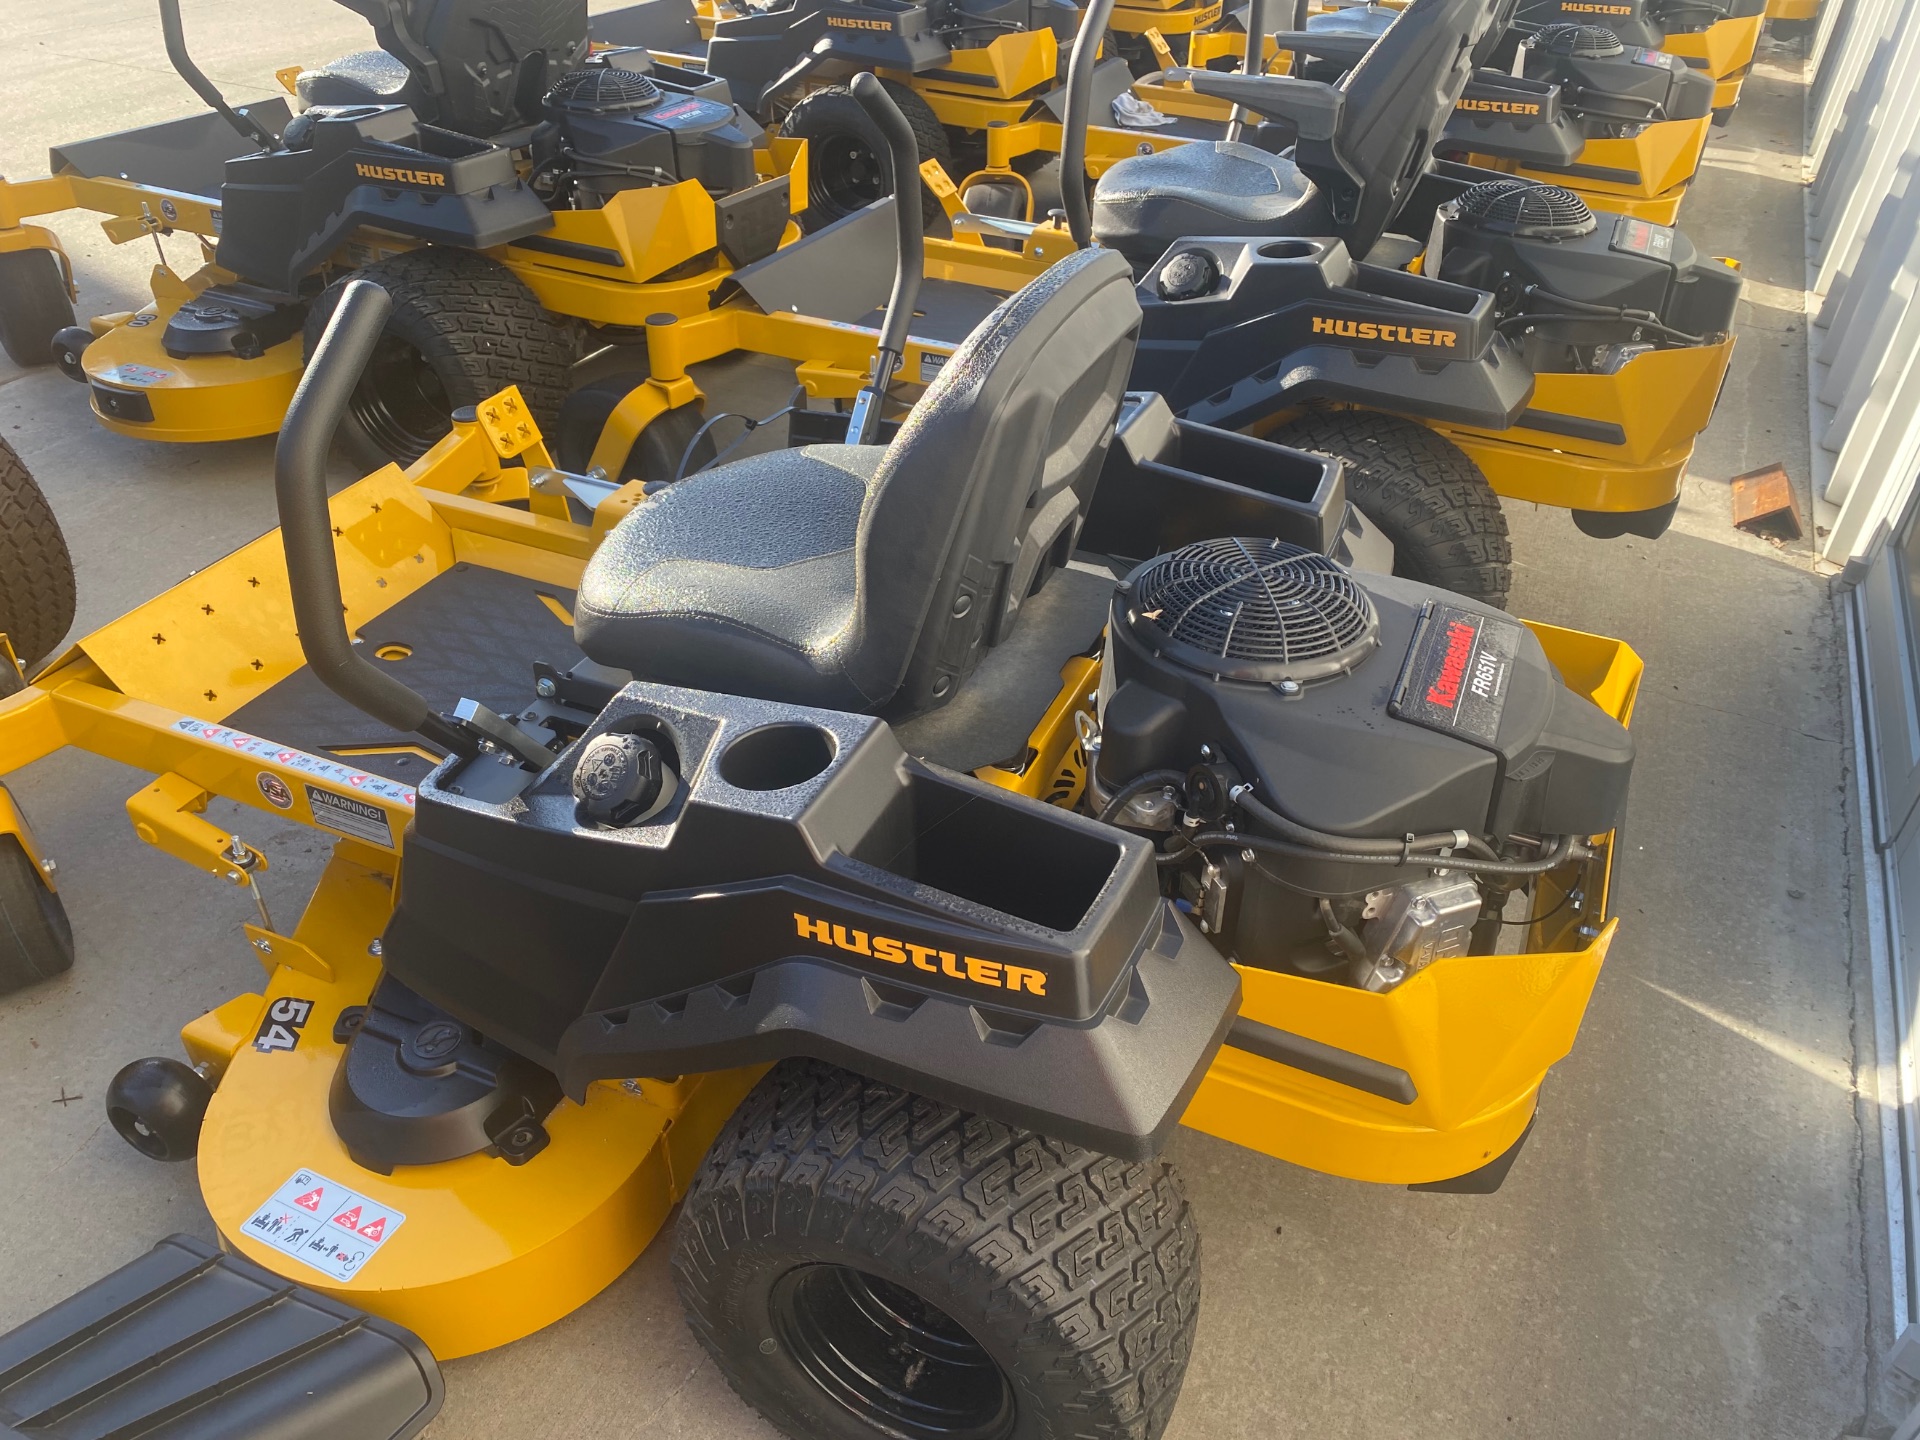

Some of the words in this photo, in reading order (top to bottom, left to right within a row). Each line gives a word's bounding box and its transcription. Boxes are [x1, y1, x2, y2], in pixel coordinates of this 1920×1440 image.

[1193, 5, 1221, 26] HUSTLER
[1561, 2, 1631, 15] HUSTLER
[827, 16, 892, 31] HUSTLER
[355, 163, 445, 186] HUSTLER
[127, 314, 157, 327] 60
[1312, 316, 1457, 348] HUSTLER
[1426, 621, 1475, 709] Kawasaki
[1471, 650, 1498, 698] FR651V
[259, 778, 291, 802] USA
[321, 791, 382, 821] WARNING!
[793, 912, 1048, 997] HUSTLER
[257, 999, 310, 1050] 54
